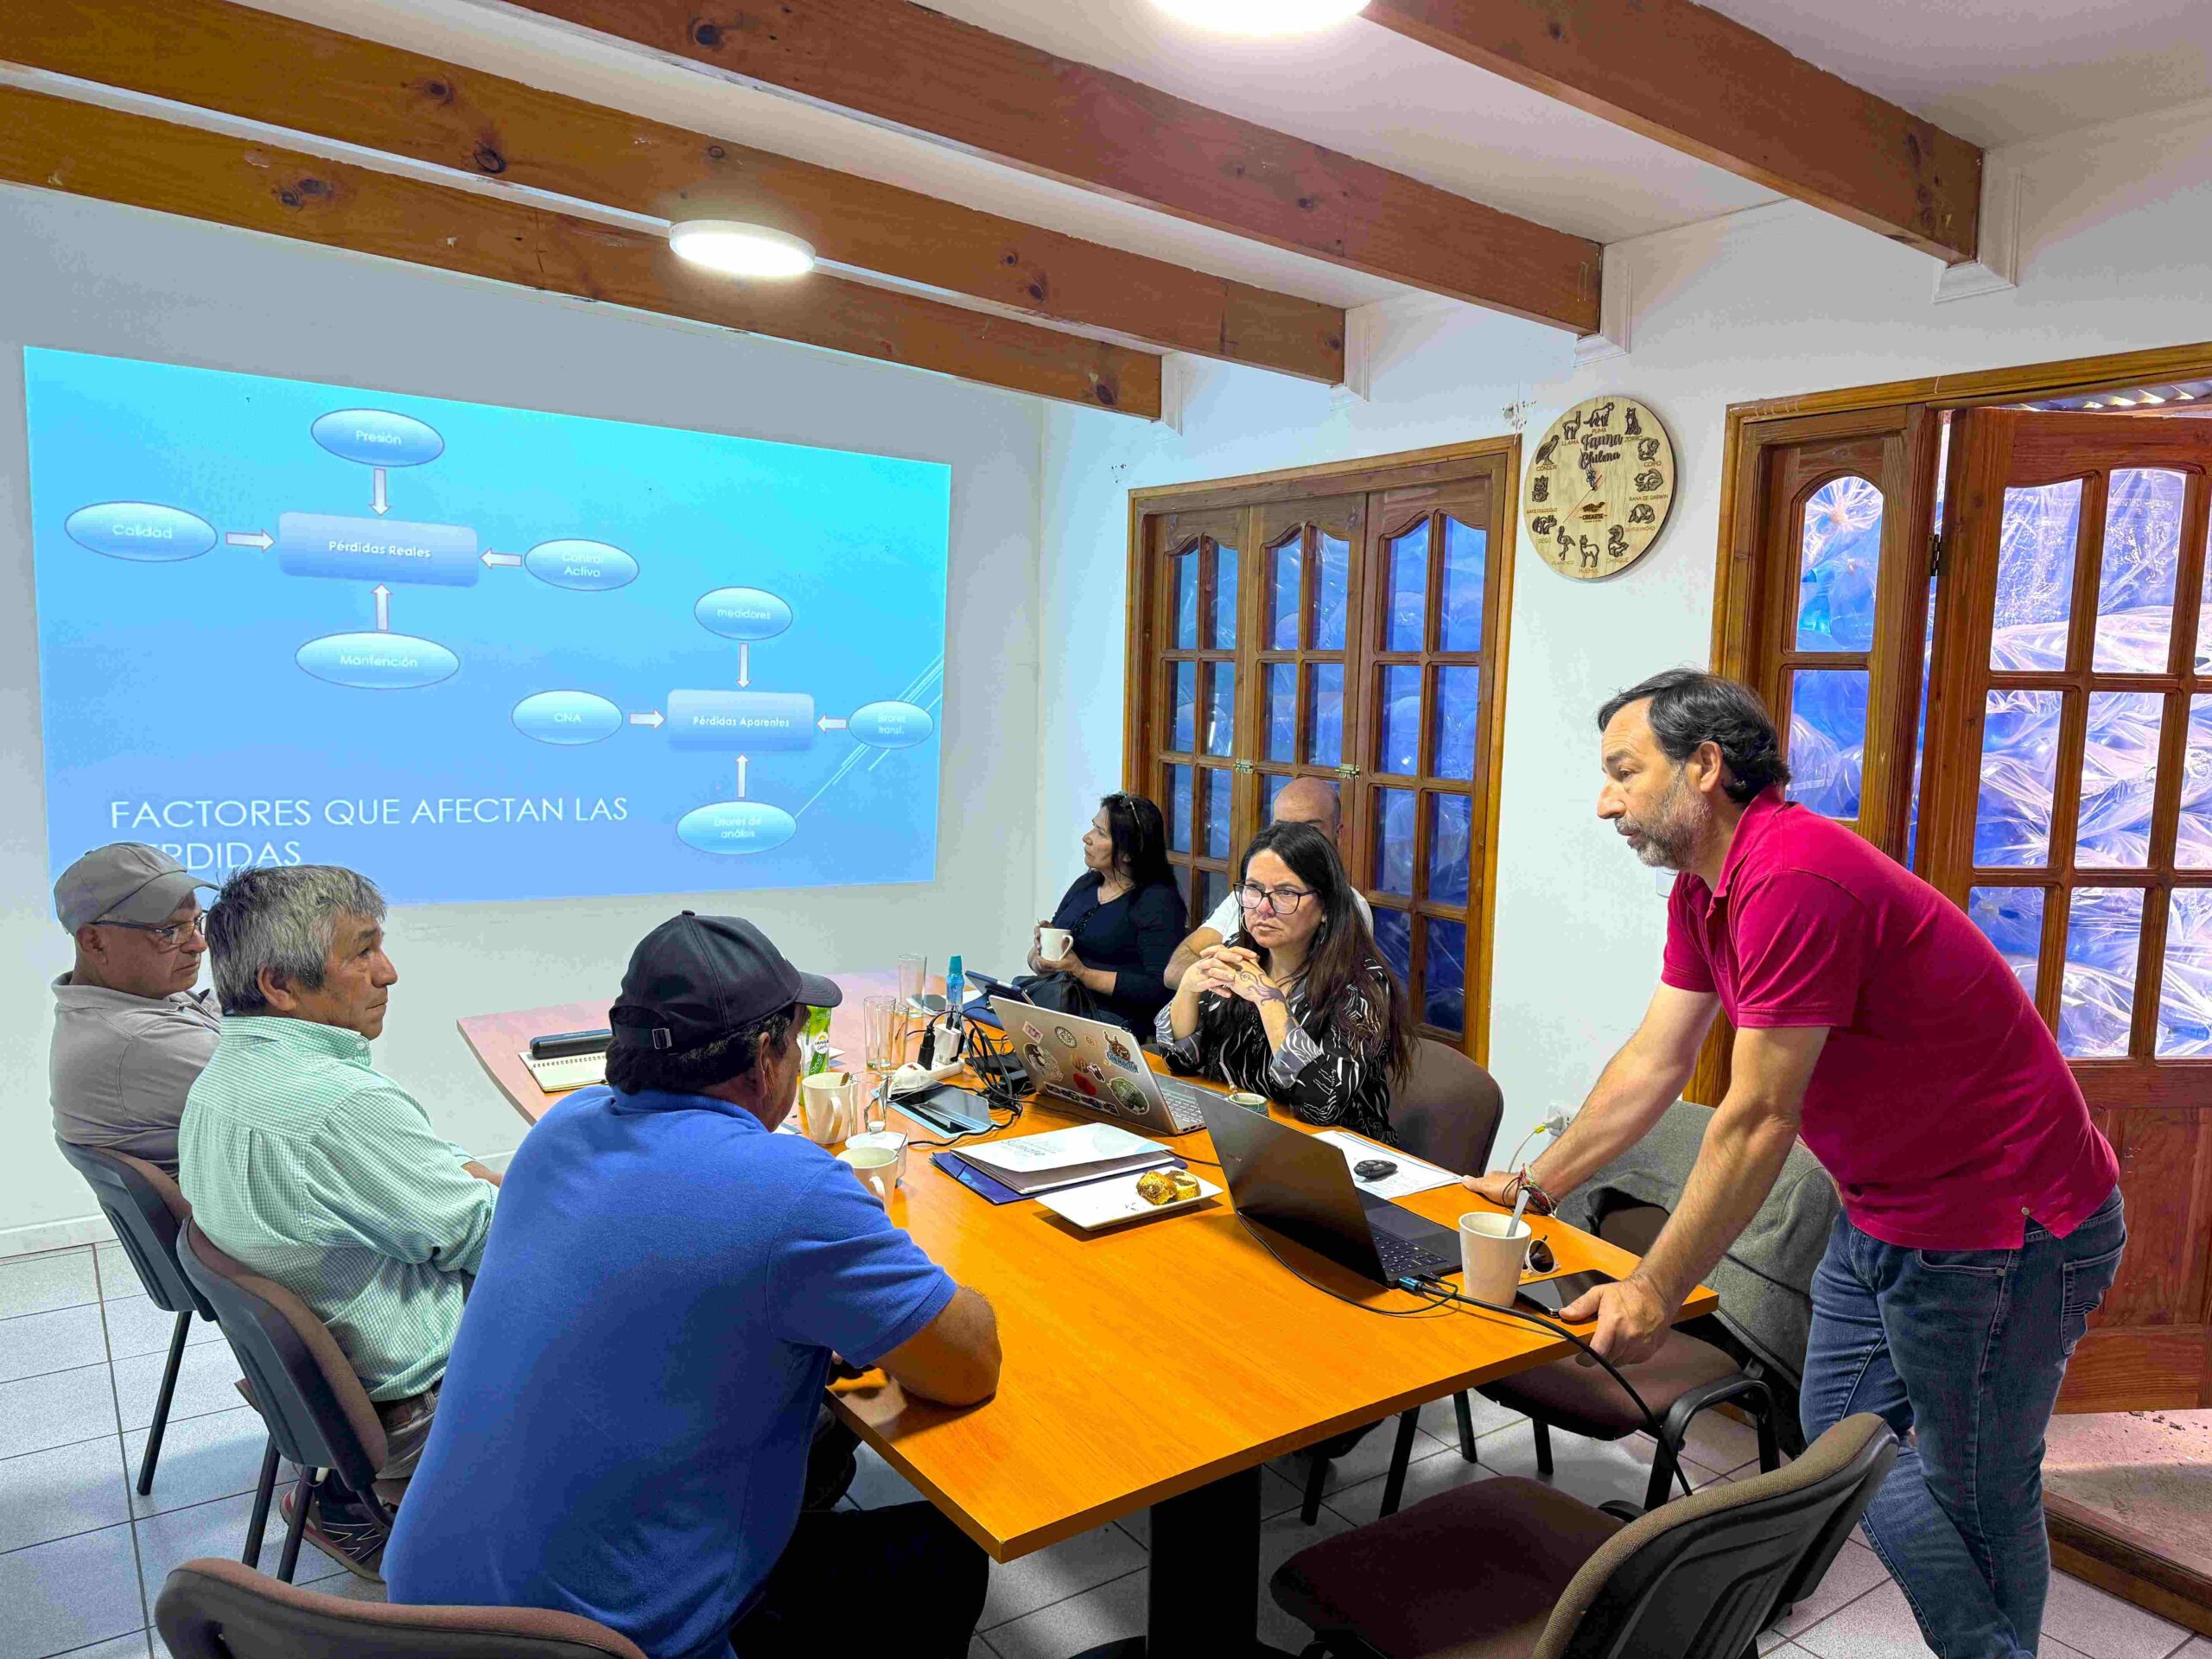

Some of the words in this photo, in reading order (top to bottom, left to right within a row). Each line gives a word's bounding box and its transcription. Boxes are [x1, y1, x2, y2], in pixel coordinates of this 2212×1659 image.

[355, 430, 402, 446] Presión
[1580, 433, 1624, 452] Fauna
[1578, 450, 1621, 470] Chilena
[111, 524, 173, 539] Calidad
[328, 539, 385, 556] Pérdidas
[388, 544, 432, 558] Reales
[563, 565, 601, 577] Activo
[339, 654, 418, 669] Mantención
[553, 712, 582, 723] CNA
[692, 715, 737, 728] Pérdidas
[740, 715, 790, 729] Aparentes
[110, 799, 311, 830] FACTORES
[324, 798, 400, 827] QUE
[410, 797, 565, 825] AFECTAN
[576, 797, 628, 823] LAS
[154, 840, 302, 870] RDIDAS
